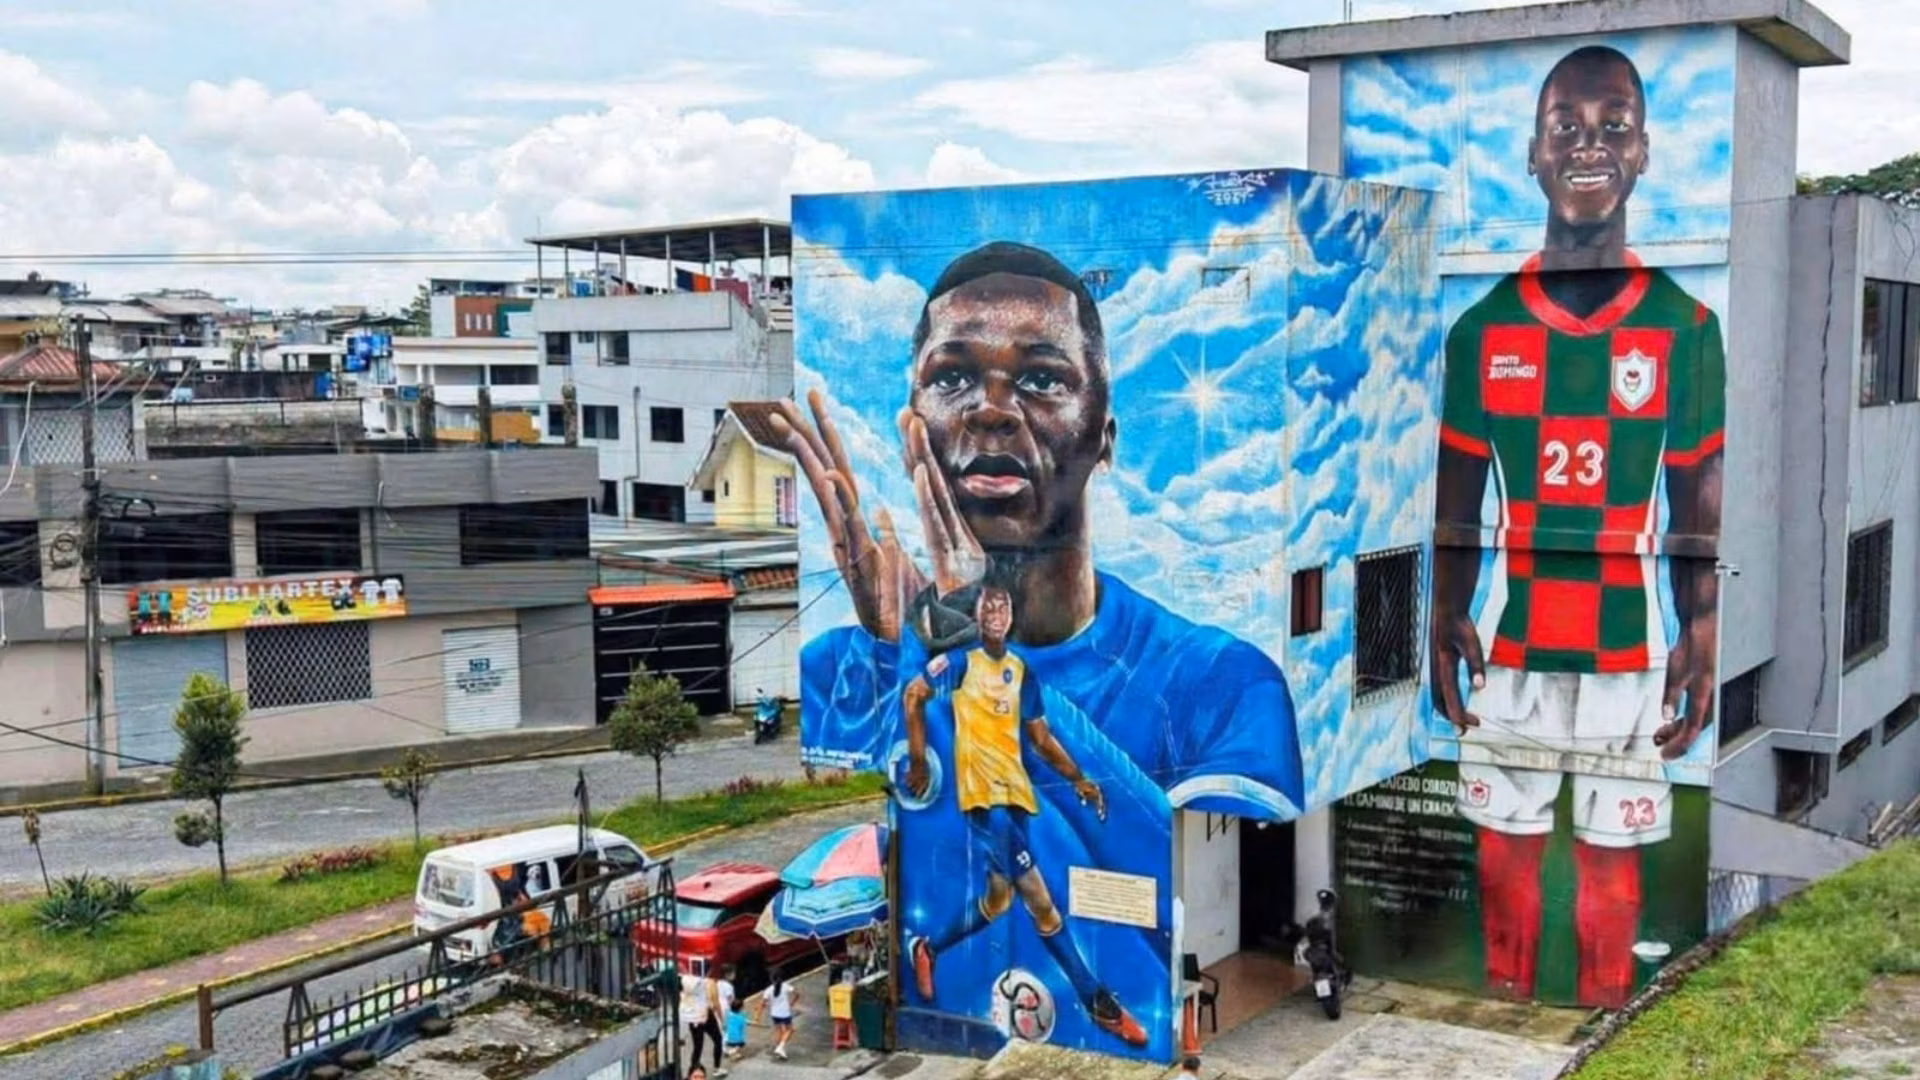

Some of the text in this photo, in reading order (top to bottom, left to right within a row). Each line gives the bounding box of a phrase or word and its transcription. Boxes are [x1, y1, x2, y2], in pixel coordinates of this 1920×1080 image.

[1491, 354, 1520, 366] SANTO
[1488, 364, 1537, 380] DOMINGO
[1543, 439, 1604, 488] 23
[187, 579, 353, 606] SUBLIARTEX
[993, 698, 1011, 715] 23
[1422, 779, 1457, 796] COROZO
[1407, 798, 1421, 814] UN
[1618, 796, 1658, 829] 23
